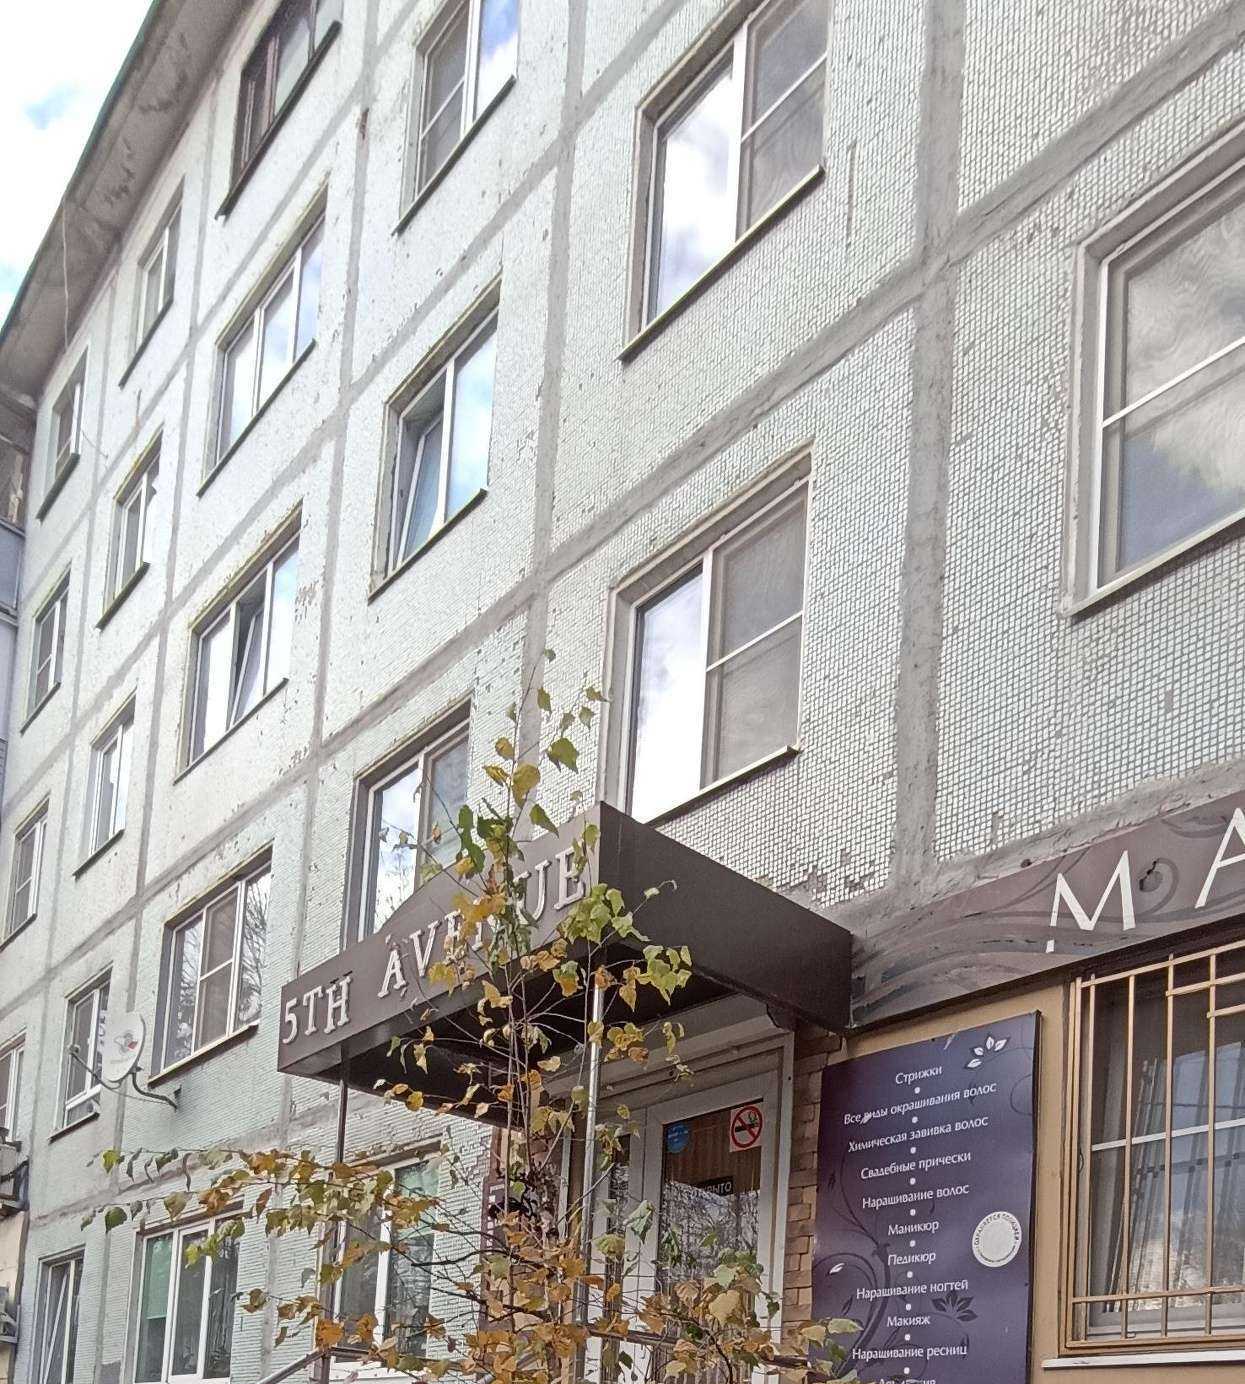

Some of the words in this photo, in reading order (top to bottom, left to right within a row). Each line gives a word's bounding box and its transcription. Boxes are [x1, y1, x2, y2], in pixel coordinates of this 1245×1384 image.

[282, 975, 352, 1044] 5TH
[895, 1066, 943, 1085] Стрижки
[843, 1112, 861, 1125] Все
[890, 1090, 961, 1115] окрашивания
[963, 1082, 997, 1098] волос
[848, 1132, 907, 1153] Химическая
[909, 1123, 952, 1140] завивка
[954, 1116, 989, 1131] волос
[860, 1162, 916, 1180] Свадебные
[918, 1152, 971, 1171] прически
[936, 1184, 970, 1198] волос
[887, 1221, 940, 1236] Маникюр
[887, 1252, 937, 1266] Педикюр
[930, 1279, 968, 1293] ногтей
[886, 1315, 931, 1327] Макияж
[926, 1345, 967, 1360] ресниц
